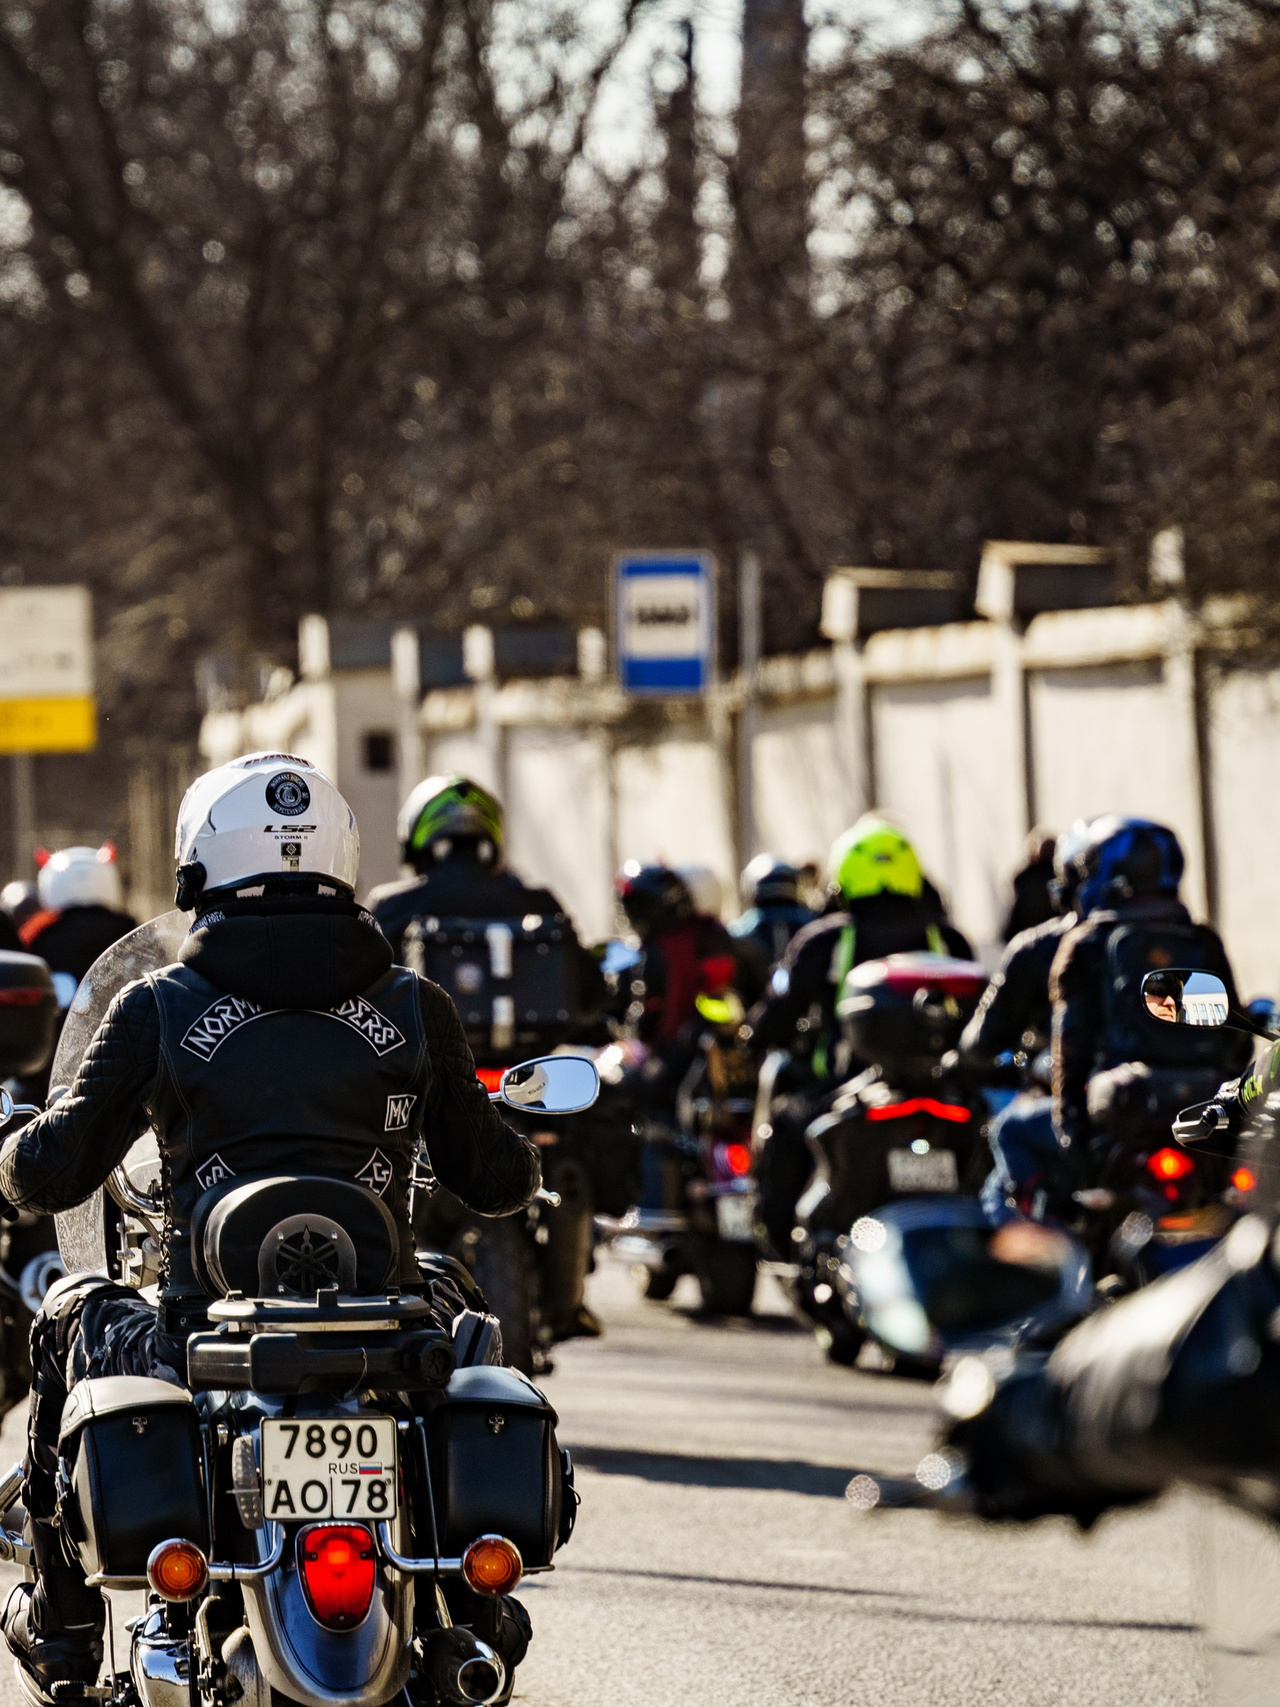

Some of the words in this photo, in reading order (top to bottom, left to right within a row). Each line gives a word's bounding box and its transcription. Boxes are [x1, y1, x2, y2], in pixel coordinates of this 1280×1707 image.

[263, 824, 317, 833] LS2
[187, 997, 261, 1053] NORM
[330, 999, 396, 1045] DERS
[388, 1098, 410, 1127] MC
[279, 1424, 378, 1459] 7890
[328, 1462, 358, 1475] RUS
[271, 1479, 328, 1514] AO
[341, 1479, 388, 1513] 78
